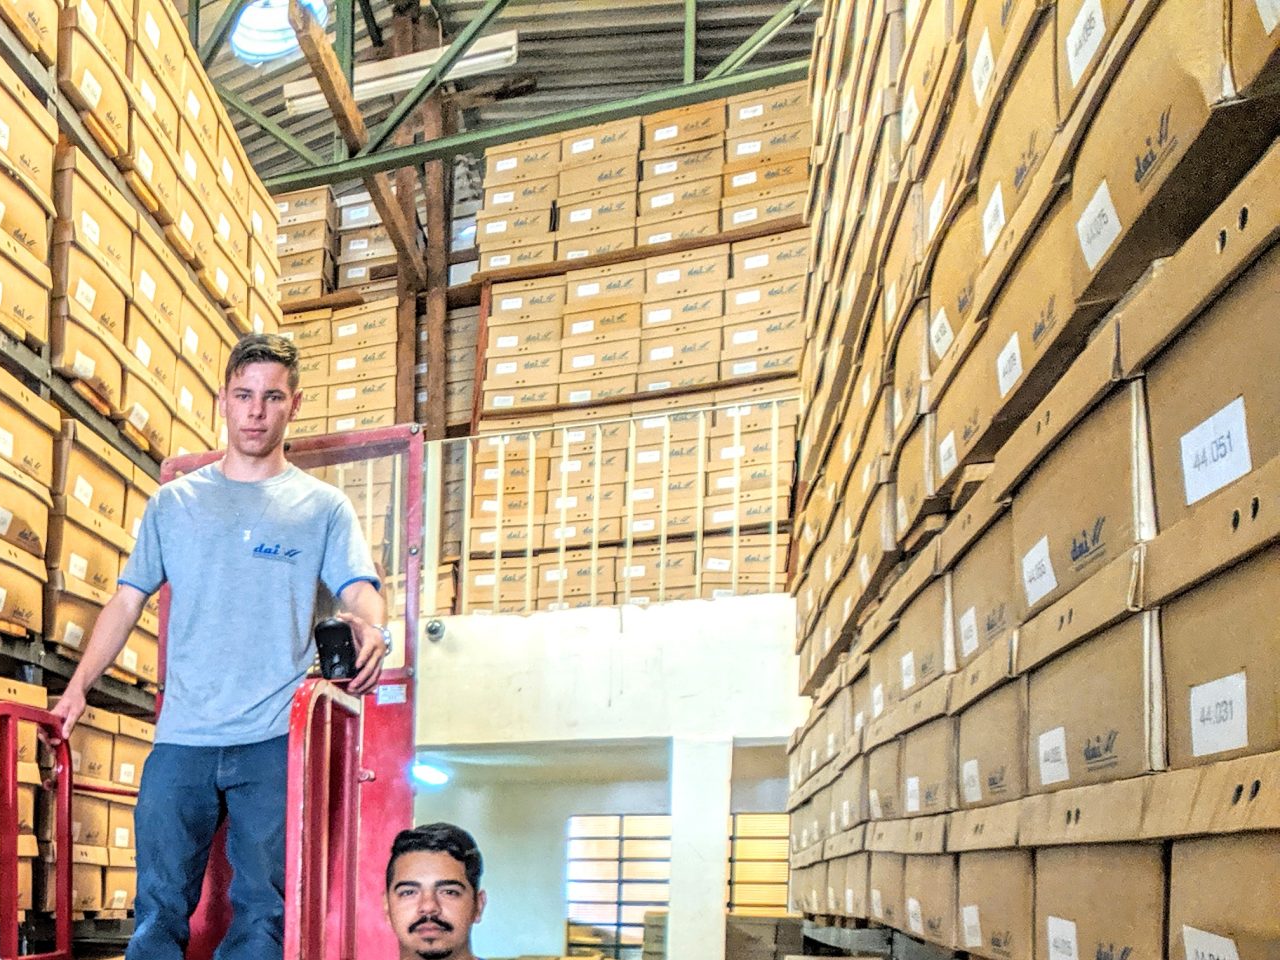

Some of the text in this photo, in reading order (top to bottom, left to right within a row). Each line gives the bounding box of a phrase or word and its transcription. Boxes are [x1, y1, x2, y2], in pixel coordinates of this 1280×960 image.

[772, 100, 788, 109] dai
[684, 121, 698, 131] dai
[600, 134, 615, 144] dai
[771, 134, 786, 145] dai
[524, 152, 538, 162] dai
[684, 155, 698, 165] dai
[598, 170, 612, 181] dai
[765, 168, 780, 178] dai
[522, 186, 536, 196] dai
[682, 190, 698, 199] dai
[295, 199, 308, 207] dai
[598, 204, 612, 213] dai
[766, 204, 781, 213] dai
[514, 218, 528, 227] dai
[294, 230, 305, 238] dai
[517, 252, 532, 261] dai
[777, 249, 793, 259] dai
[292, 259, 303, 267] dai
[688, 266, 703, 275] dai
[607, 280, 622, 289] dai
[288, 287, 299, 296] dai
[769, 287, 783, 296] dai
[530, 295, 544, 304] dai
[683, 302, 698, 312] dai
[600, 315, 615, 324] dai
[364, 320, 376, 329] dai
[767, 321, 781, 332] dai
[526, 332, 540, 342] dai
[682, 343, 697, 352] dai
[363, 353, 375, 361] dai
[602, 352, 616, 360] dai
[524, 359, 539, 368] dai
[764, 357, 779, 368] dai
[521, 392, 535, 401] dai
[670, 446, 684, 456] dai
[753, 444, 768, 452] dai
[1193, 430, 1234, 472] 44.051
[510, 468, 526, 476] dai
[751, 470, 766, 478] dai
[746, 506, 761, 515] dai
[507, 530, 522, 539] dai
[253, 543, 280, 554] dai
[745, 553, 760, 562] dai
[577, 567, 592, 576] dai
[502, 574, 517, 582] dai
[1199, 700, 1234, 725] 44.031
